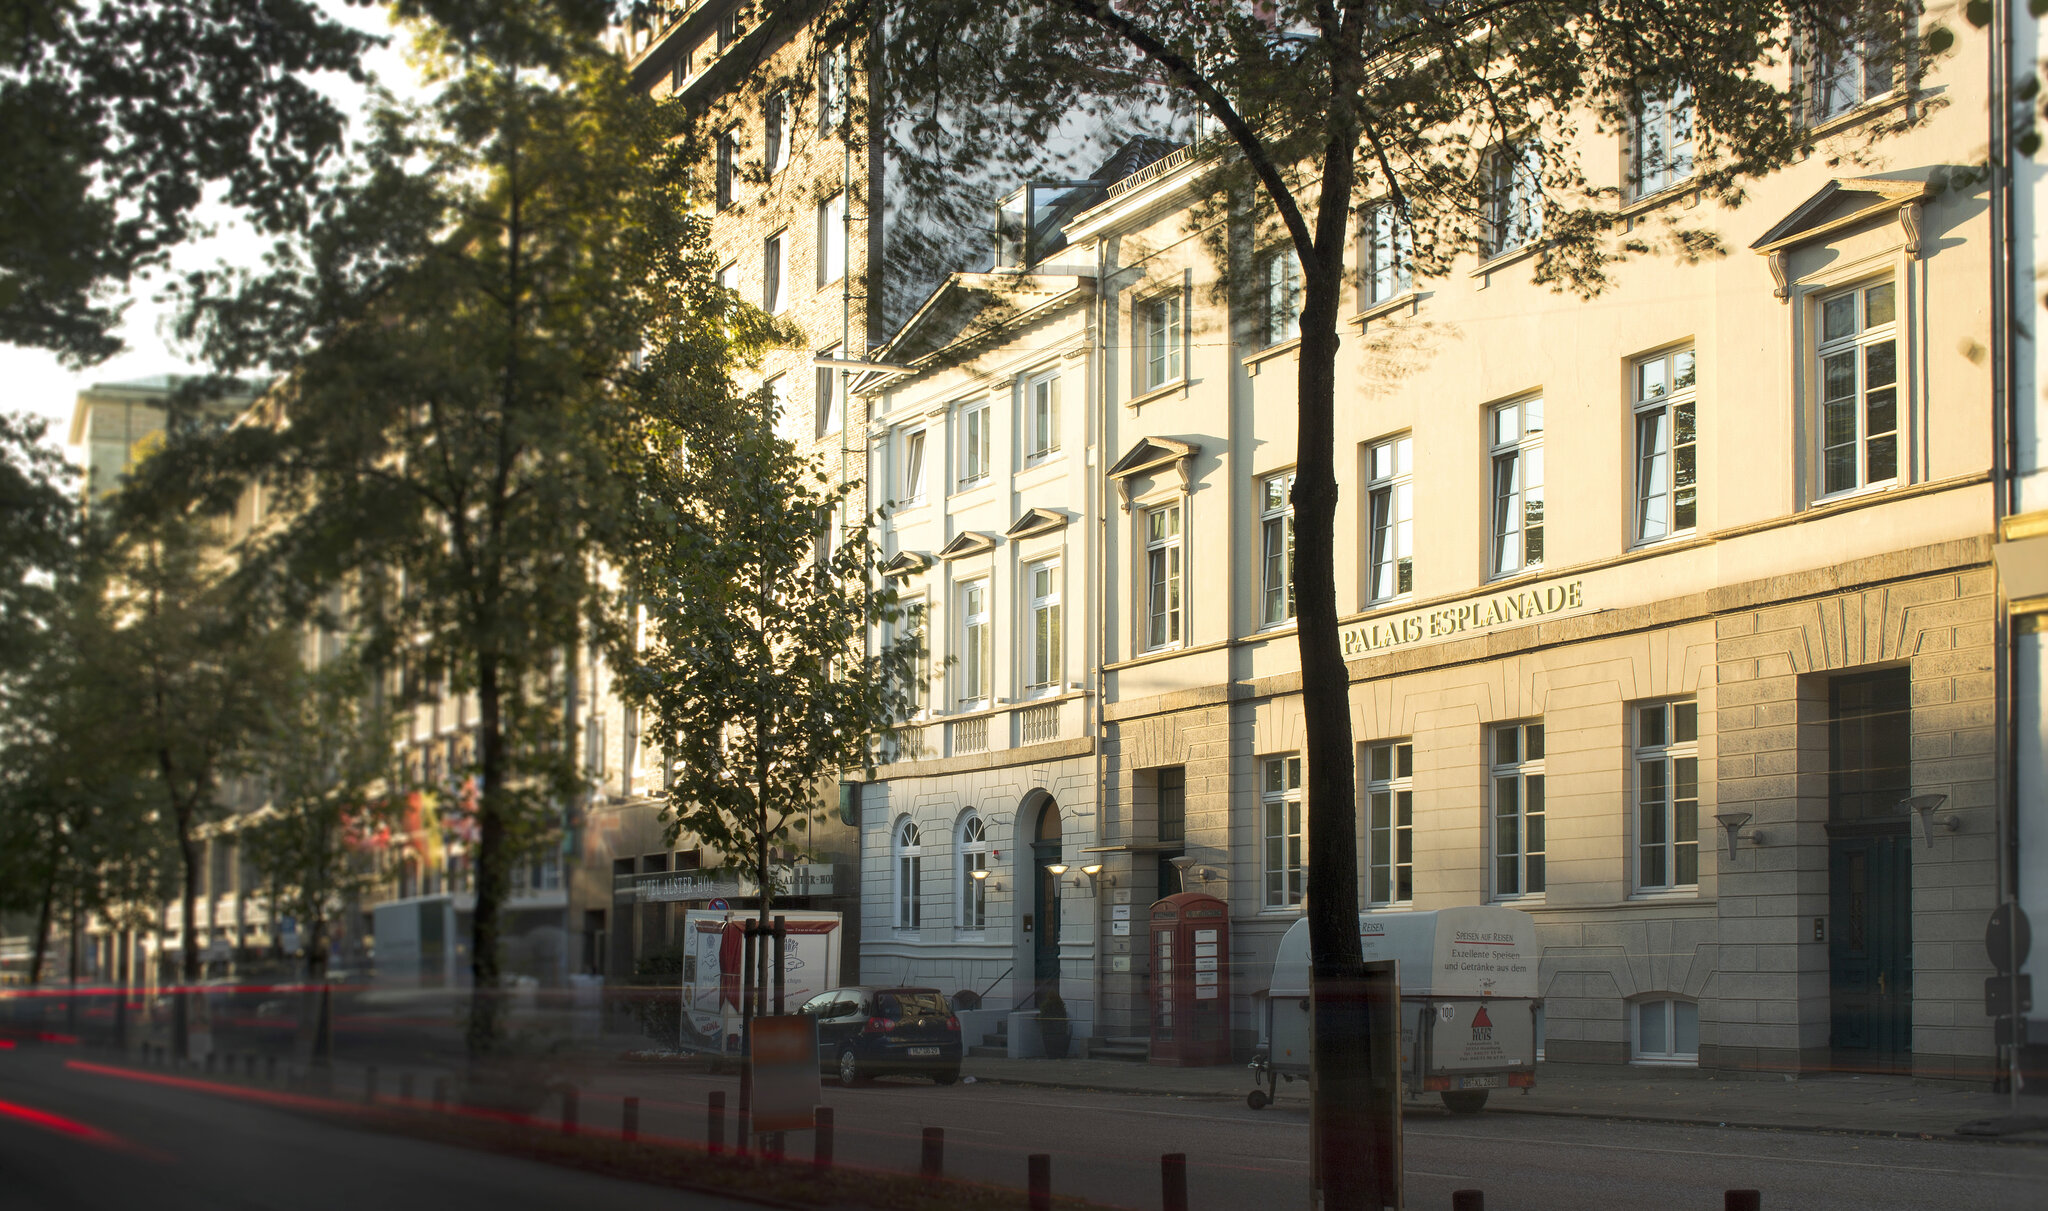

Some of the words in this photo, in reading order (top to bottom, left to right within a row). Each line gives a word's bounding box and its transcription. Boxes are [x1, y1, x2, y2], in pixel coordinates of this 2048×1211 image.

[1343, 615, 1423, 656] PALAIS
[1429, 580, 1583, 638] ESPLANADE
[636, 879, 661, 896] HOTEL
[1493, 933, 1514, 942] REISEN
[1451, 949, 1490, 958] Exzellente
[1492, 951, 1520, 960] Speisen
[1444, 962, 1458, 970] und
[1497, 964, 1509, 972] aus
[1511, 964, 1527, 972] dem
[1442, 1007, 1454, 1018] 100
[1473, 1033, 1493, 1041] HUIS
